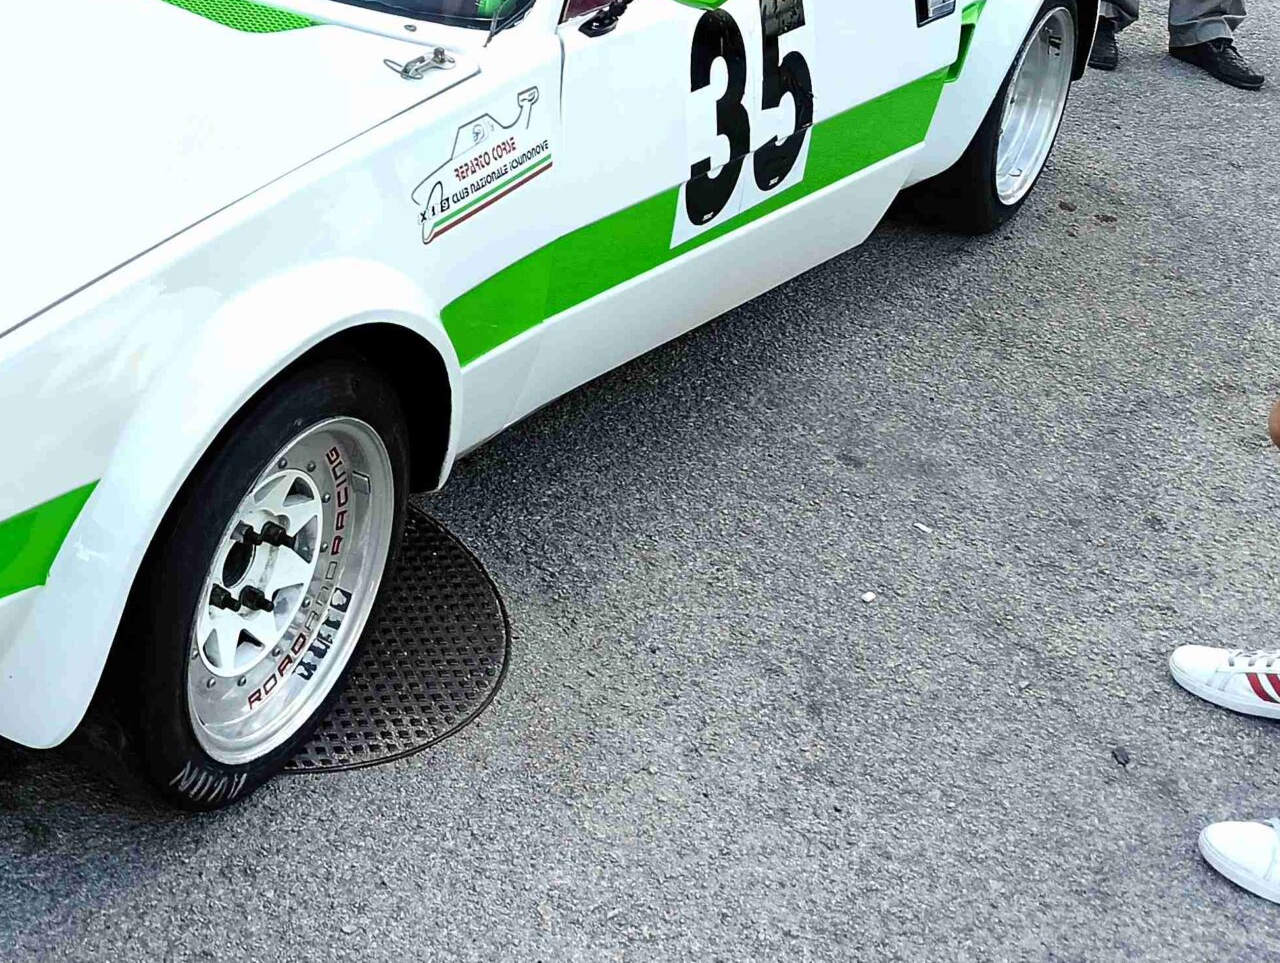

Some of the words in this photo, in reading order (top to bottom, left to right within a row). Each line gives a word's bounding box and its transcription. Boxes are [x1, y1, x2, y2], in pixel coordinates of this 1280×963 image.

[453, 151, 491, 182] REPARTO
[491, 136, 517, 161] CORSE
[451, 187, 470, 205] CLUB
[470, 163, 509, 195] NAZIONALE
